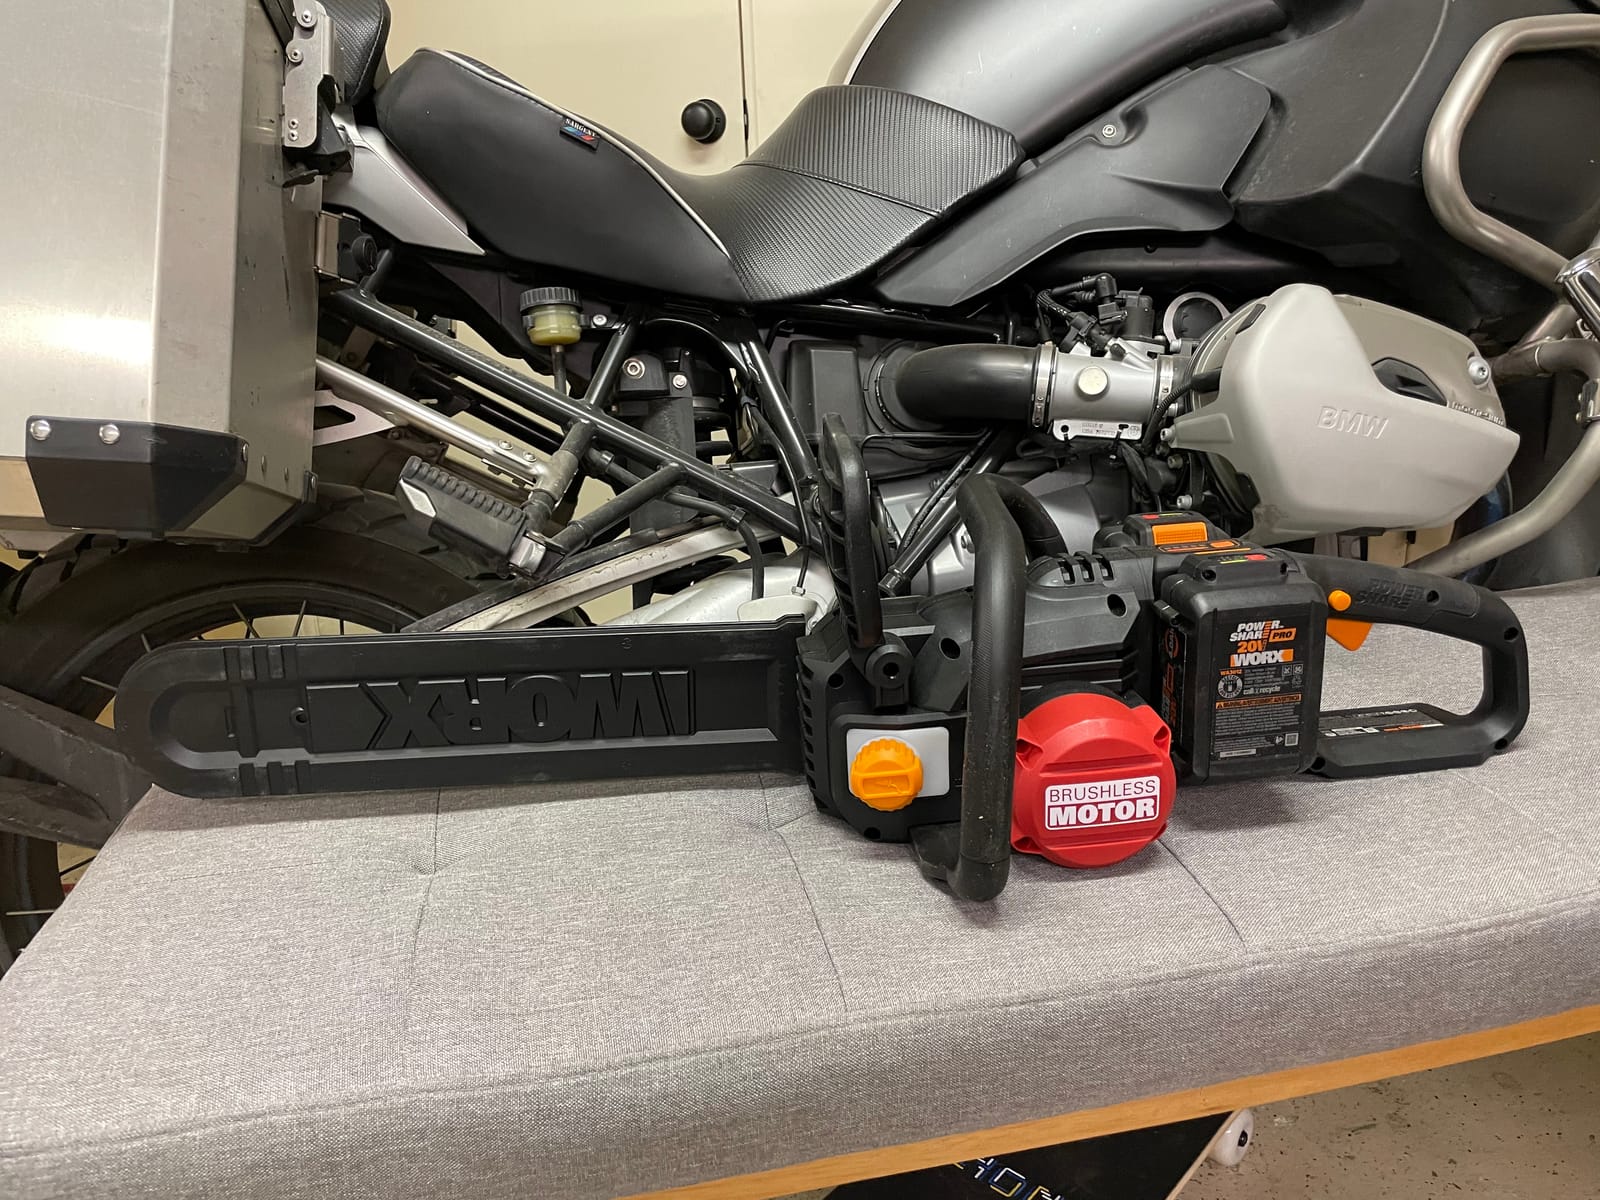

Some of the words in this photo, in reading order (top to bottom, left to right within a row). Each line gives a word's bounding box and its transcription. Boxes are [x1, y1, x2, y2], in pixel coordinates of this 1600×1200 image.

[1317, 405, 1389, 440] BMW
[1237, 620, 1281, 633] POWER
[1272, 630, 1293, 640] PRO
[1234, 650, 1284, 667] WORX
[366, 672, 676, 750] WORX
[1049, 780, 1156, 803] BRUSHLESS
[1049, 798, 1155, 826] MOTOR
